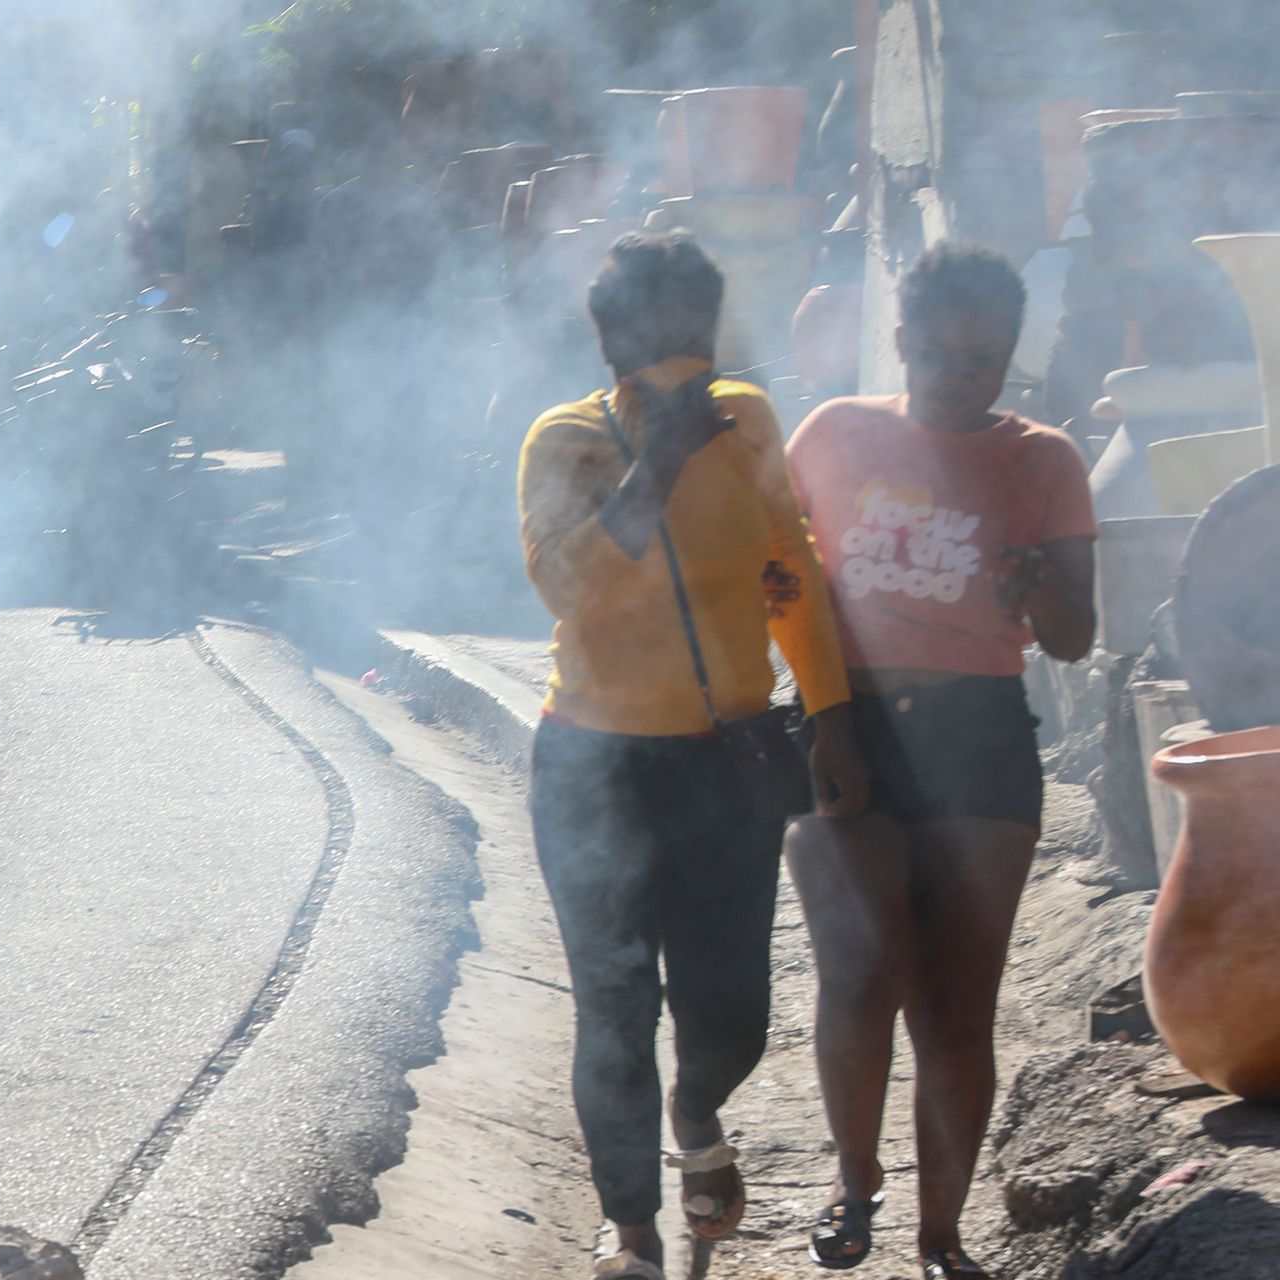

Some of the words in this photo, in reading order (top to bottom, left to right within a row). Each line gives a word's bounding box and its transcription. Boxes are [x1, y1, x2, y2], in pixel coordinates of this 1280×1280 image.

[860, 486, 982, 541] focus
[840, 526, 897, 561] on
[906, 533, 983, 576] the
[841, 556, 968, 603] good
